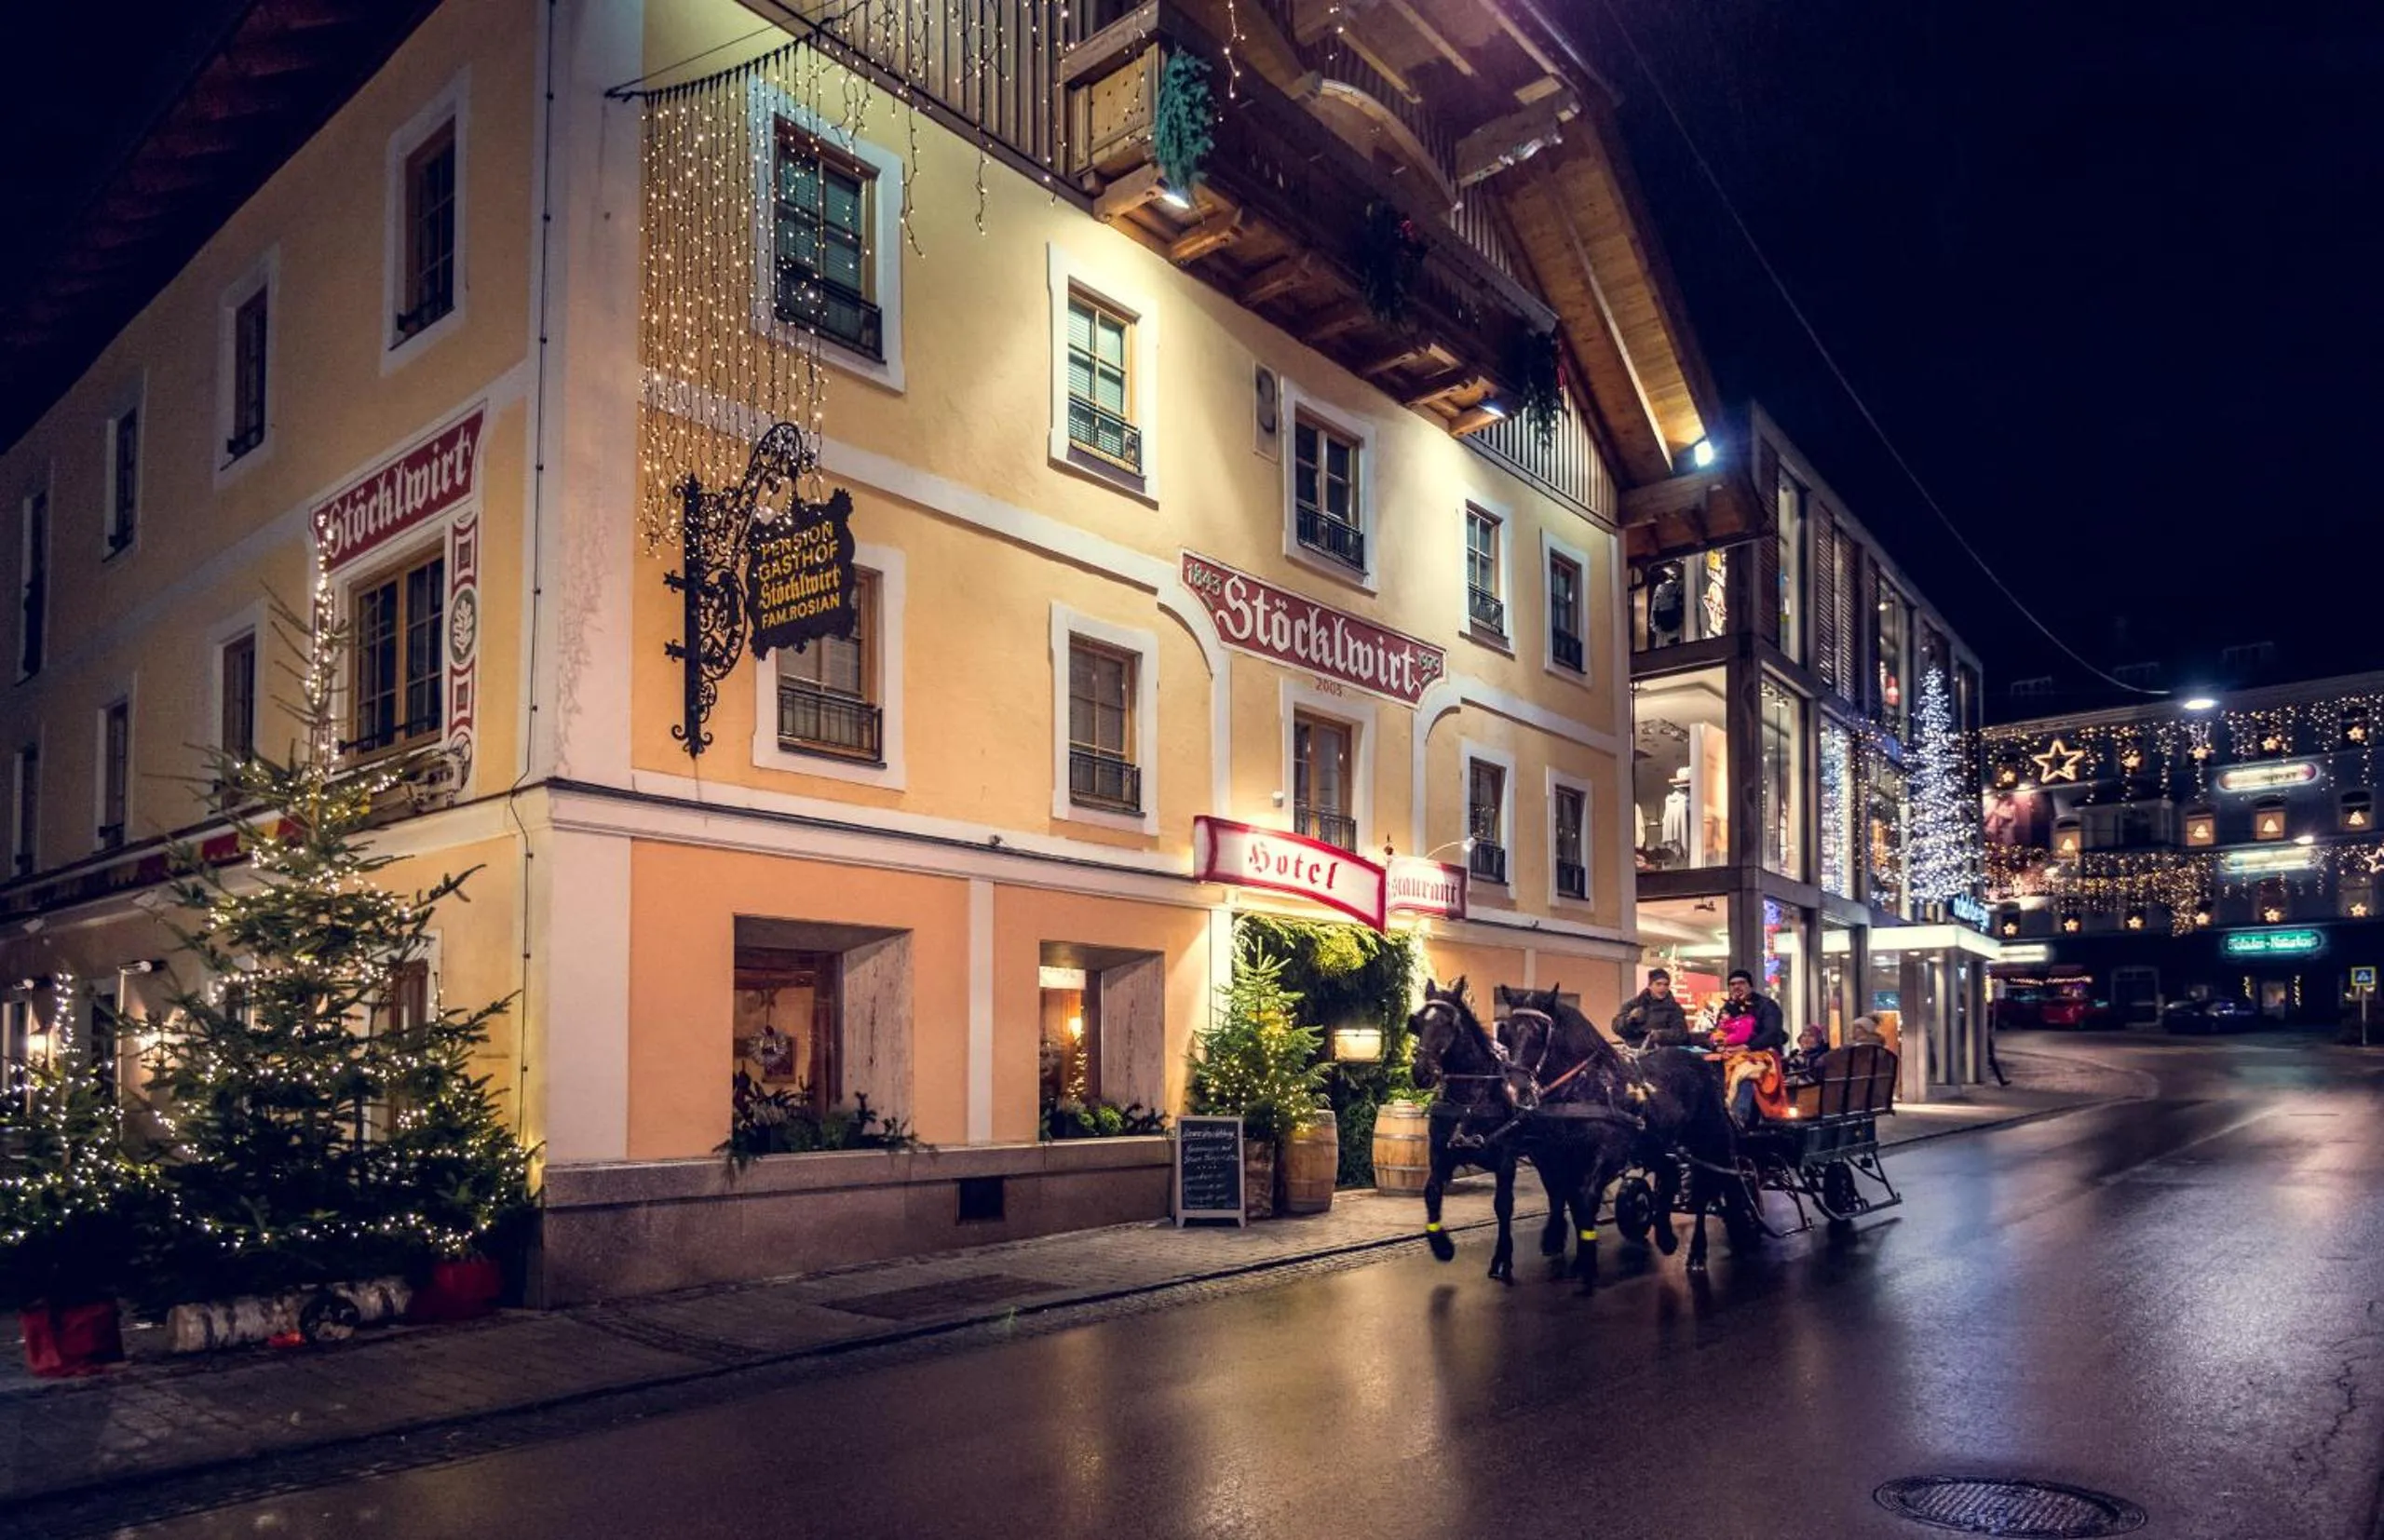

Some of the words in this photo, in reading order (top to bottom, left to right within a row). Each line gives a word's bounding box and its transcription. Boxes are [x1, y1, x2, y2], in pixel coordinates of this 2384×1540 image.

[326, 425, 472, 560] Stöcklwirt
[758, 541, 839, 581] GASTHOF
[761, 520, 834, 560] PENSION
[759, 564, 842, 610] Stöcklwirt
[1215, 574, 1421, 696] Stöcklwirt
[1249, 840, 1338, 890] Hotel
[1391, 876, 1456, 904] staurant
